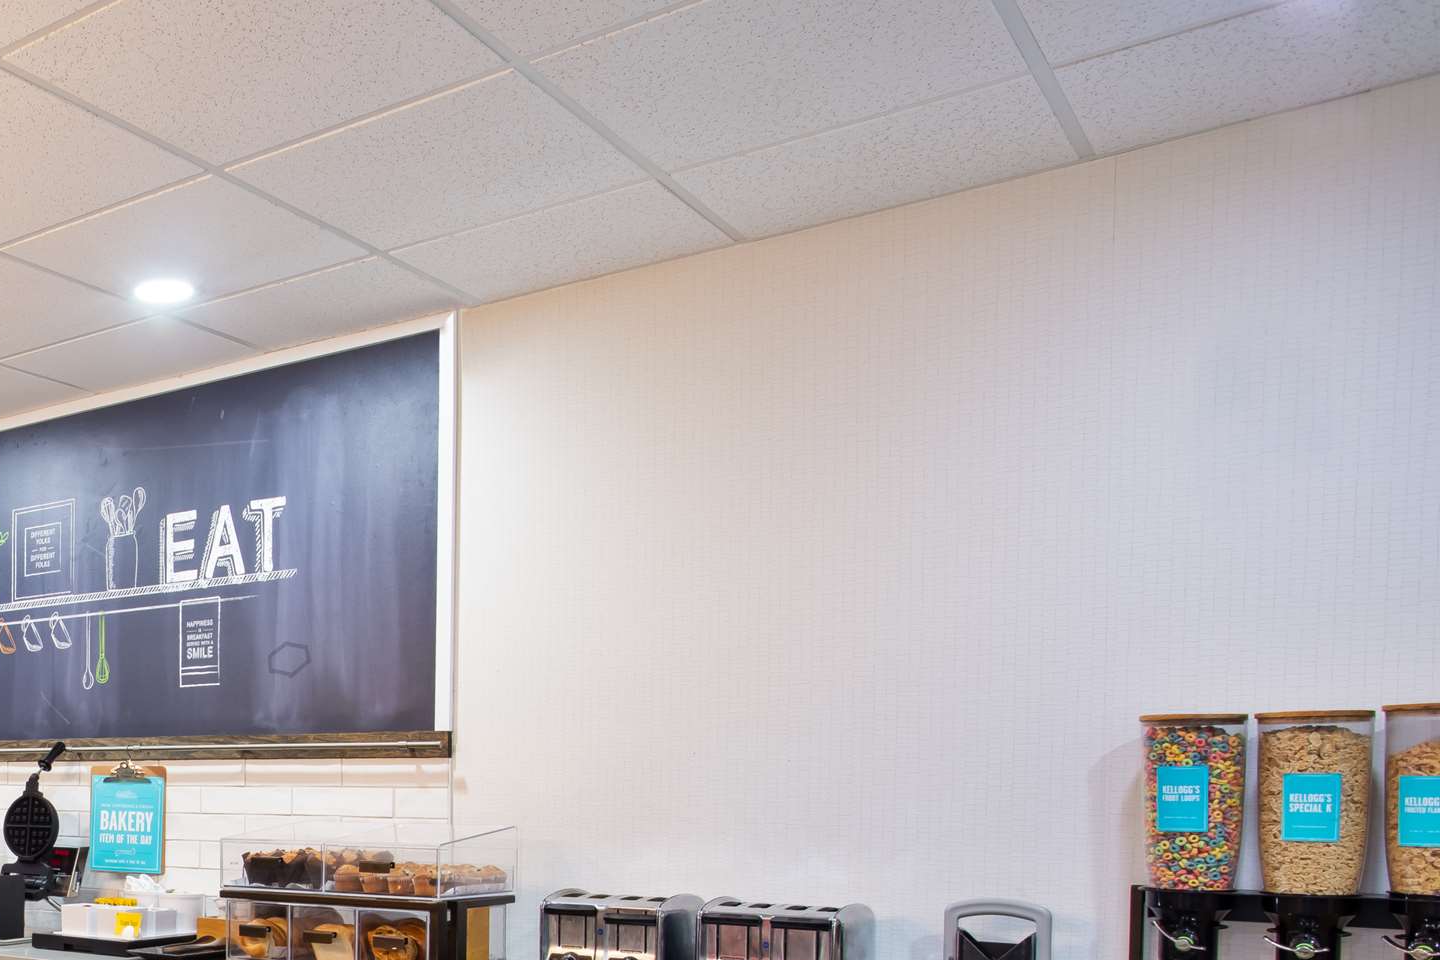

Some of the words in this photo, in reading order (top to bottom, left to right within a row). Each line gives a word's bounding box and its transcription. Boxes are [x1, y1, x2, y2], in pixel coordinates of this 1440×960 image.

[30, 527, 56, 539] DIFFERENT
[161, 496, 287, 584] EAT
[30, 551, 56, 562] DIFFERENT
[186, 618, 214, 628] HAPPINESS
[186, 632, 213, 641] BREAKFAST
[186, 646, 214, 660] SMILE
[1162, 785, 1201, 794] KELLOGG'S
[1289, 793, 1332, 803] KELLOGG'S
[1404, 796, 1440, 806] KELLOGG
[1289, 803, 1323, 813] SPECIAL
[1325, 803, 1333, 813] K
[99, 810, 154, 833] BAKERY
[99, 832, 115, 844] ITEM
[116, 833, 125, 844] OF
[126, 833, 138, 845] THE
[139, 834, 153, 846] DAY
